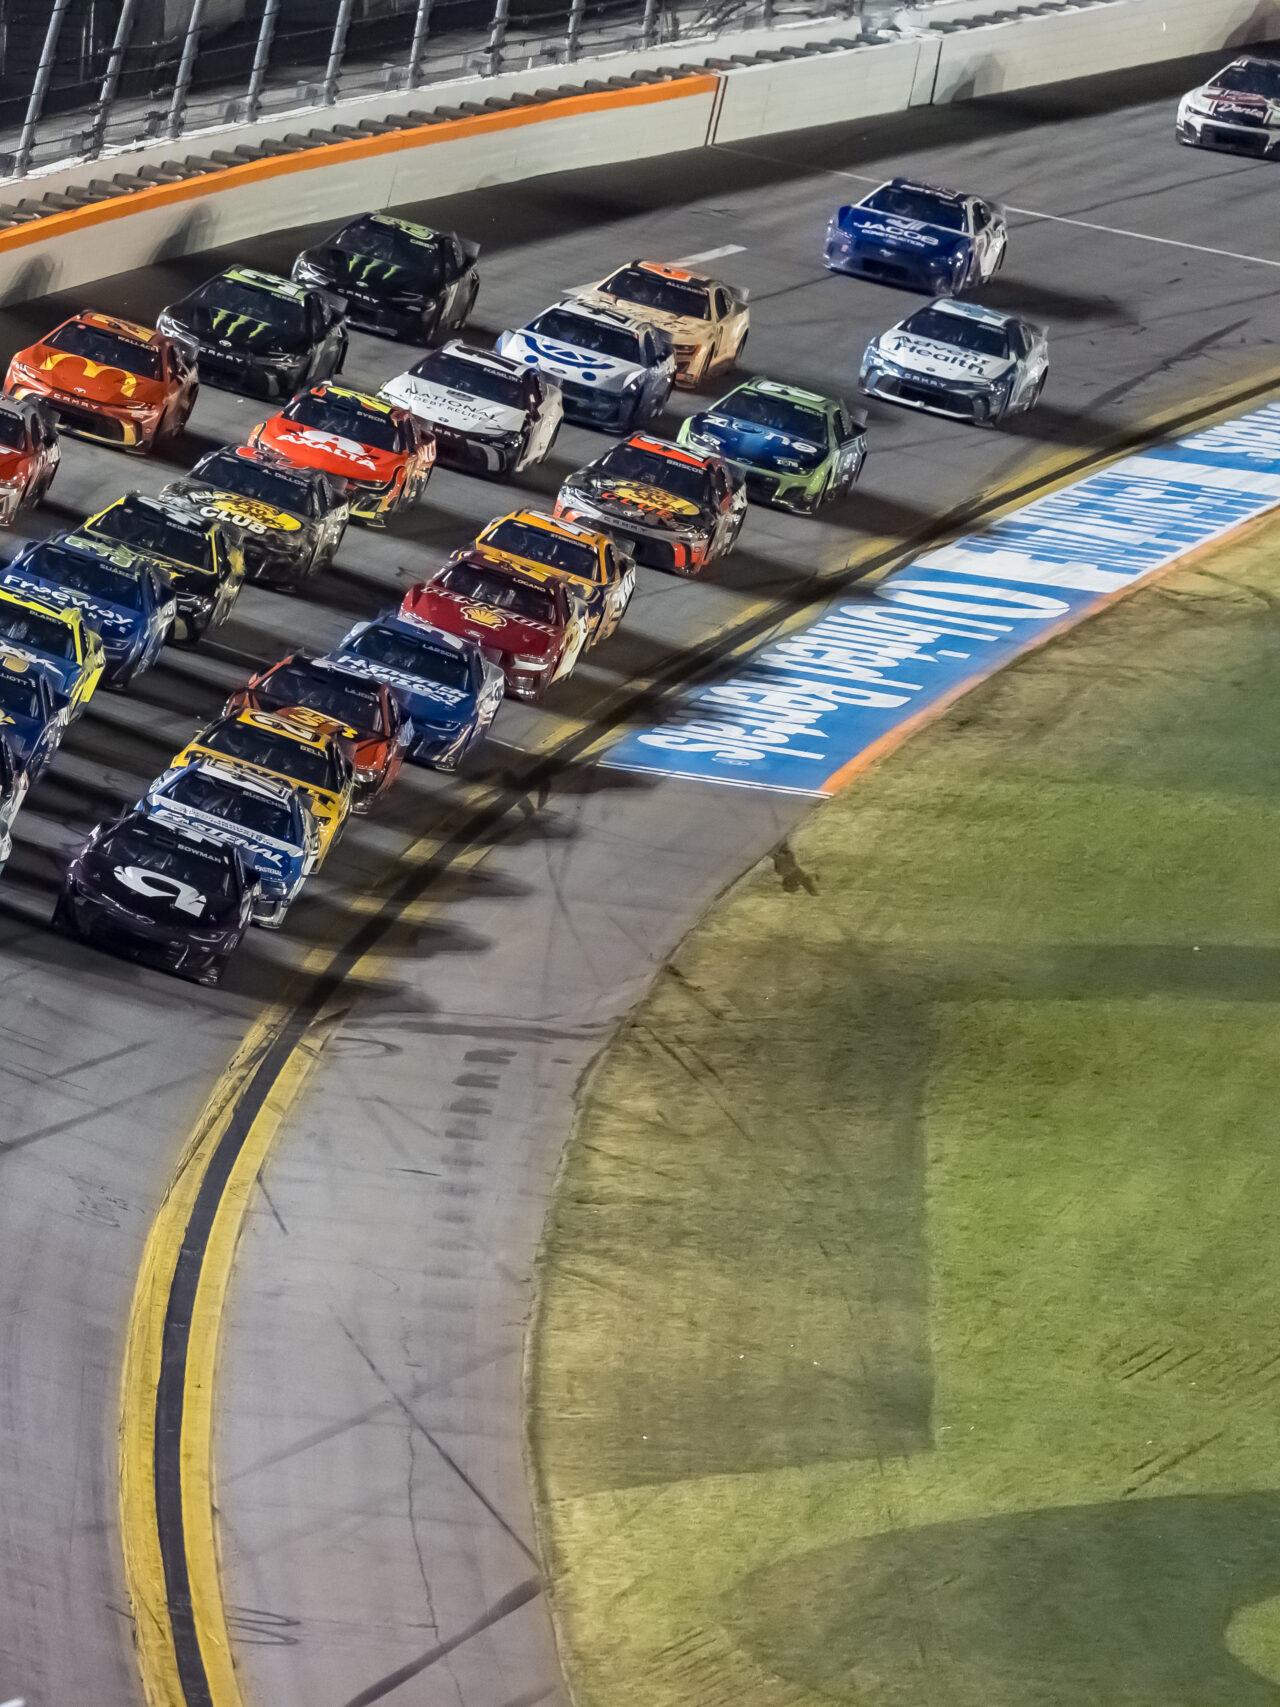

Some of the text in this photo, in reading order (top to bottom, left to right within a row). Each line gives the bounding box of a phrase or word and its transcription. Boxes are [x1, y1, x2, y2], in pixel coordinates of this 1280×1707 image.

[53, 393, 99, 411] CAMRY
[405, 388, 499, 423] NATIONAL
[275, 433, 377, 471] AXALTA
[666, 458, 705, 475] BRISCOE
[199, 505, 268, 536] CLUB
[512, 577, 547, 593] LOGANO
[422, 643, 459, 661] LARSON
[637, 603, 1016, 761] United Rentals
[177, 843, 222, 865] BOWMAN
